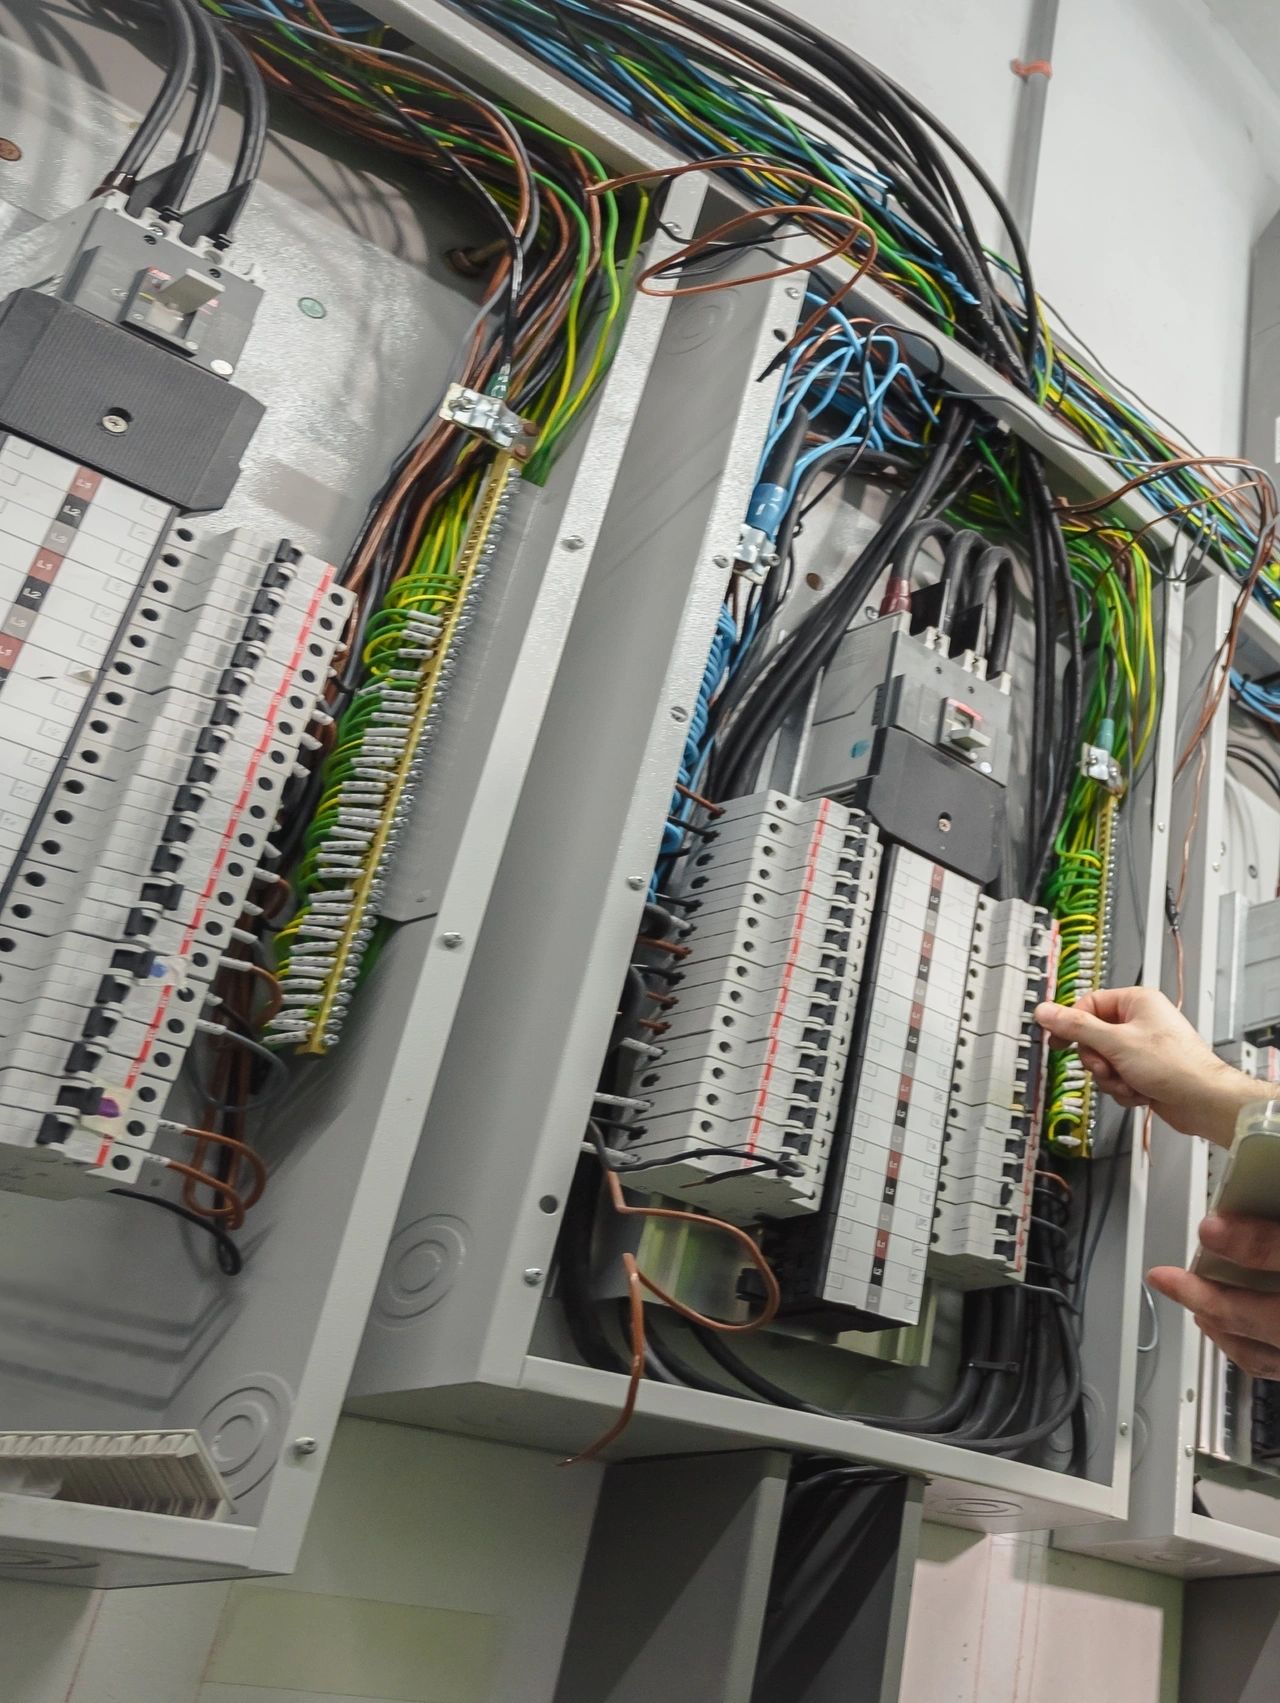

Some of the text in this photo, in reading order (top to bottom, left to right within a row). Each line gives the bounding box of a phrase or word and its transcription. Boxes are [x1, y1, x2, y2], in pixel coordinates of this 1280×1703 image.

[63, 505, 81, 517] L2
[36, 559, 53, 570] L1
[23, 588, 42, 599] L2
[885, 1186, 895, 1195] L2
[873, 1266, 882, 1276] L2
